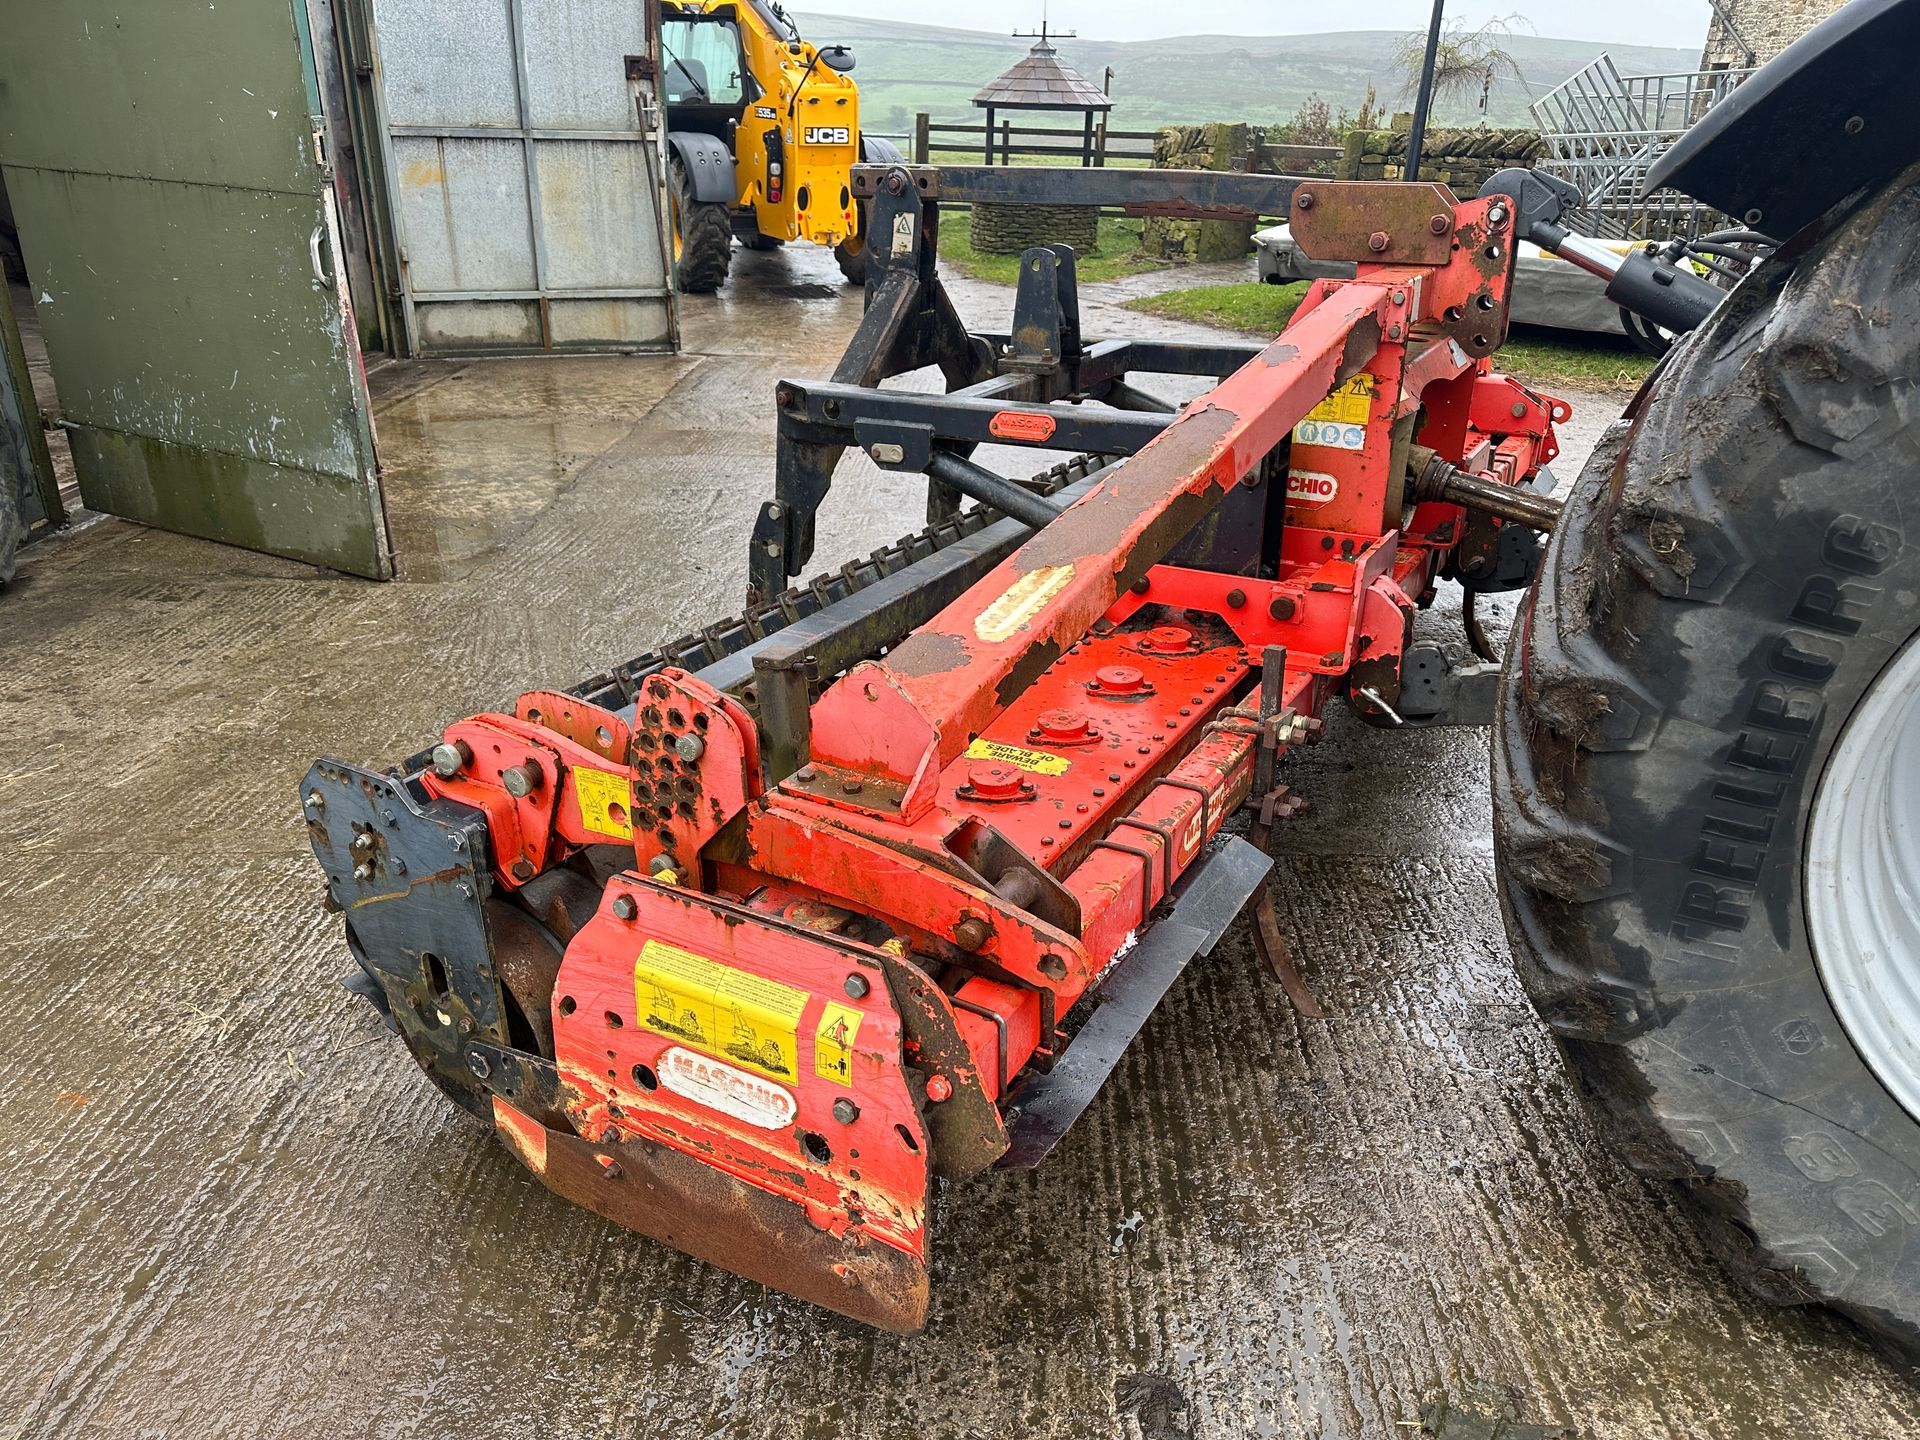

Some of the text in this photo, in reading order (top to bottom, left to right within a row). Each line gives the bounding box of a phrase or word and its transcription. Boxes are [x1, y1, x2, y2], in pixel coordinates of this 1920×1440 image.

[805, 128, 849, 144] JCB
[999, 414, 1051, 430] MASCHIO
[1664, 513, 1903, 964] TRELLEBORG
[985, 744, 1055, 762] OF BLADES
[988, 750, 1040, 766] BEWARE
